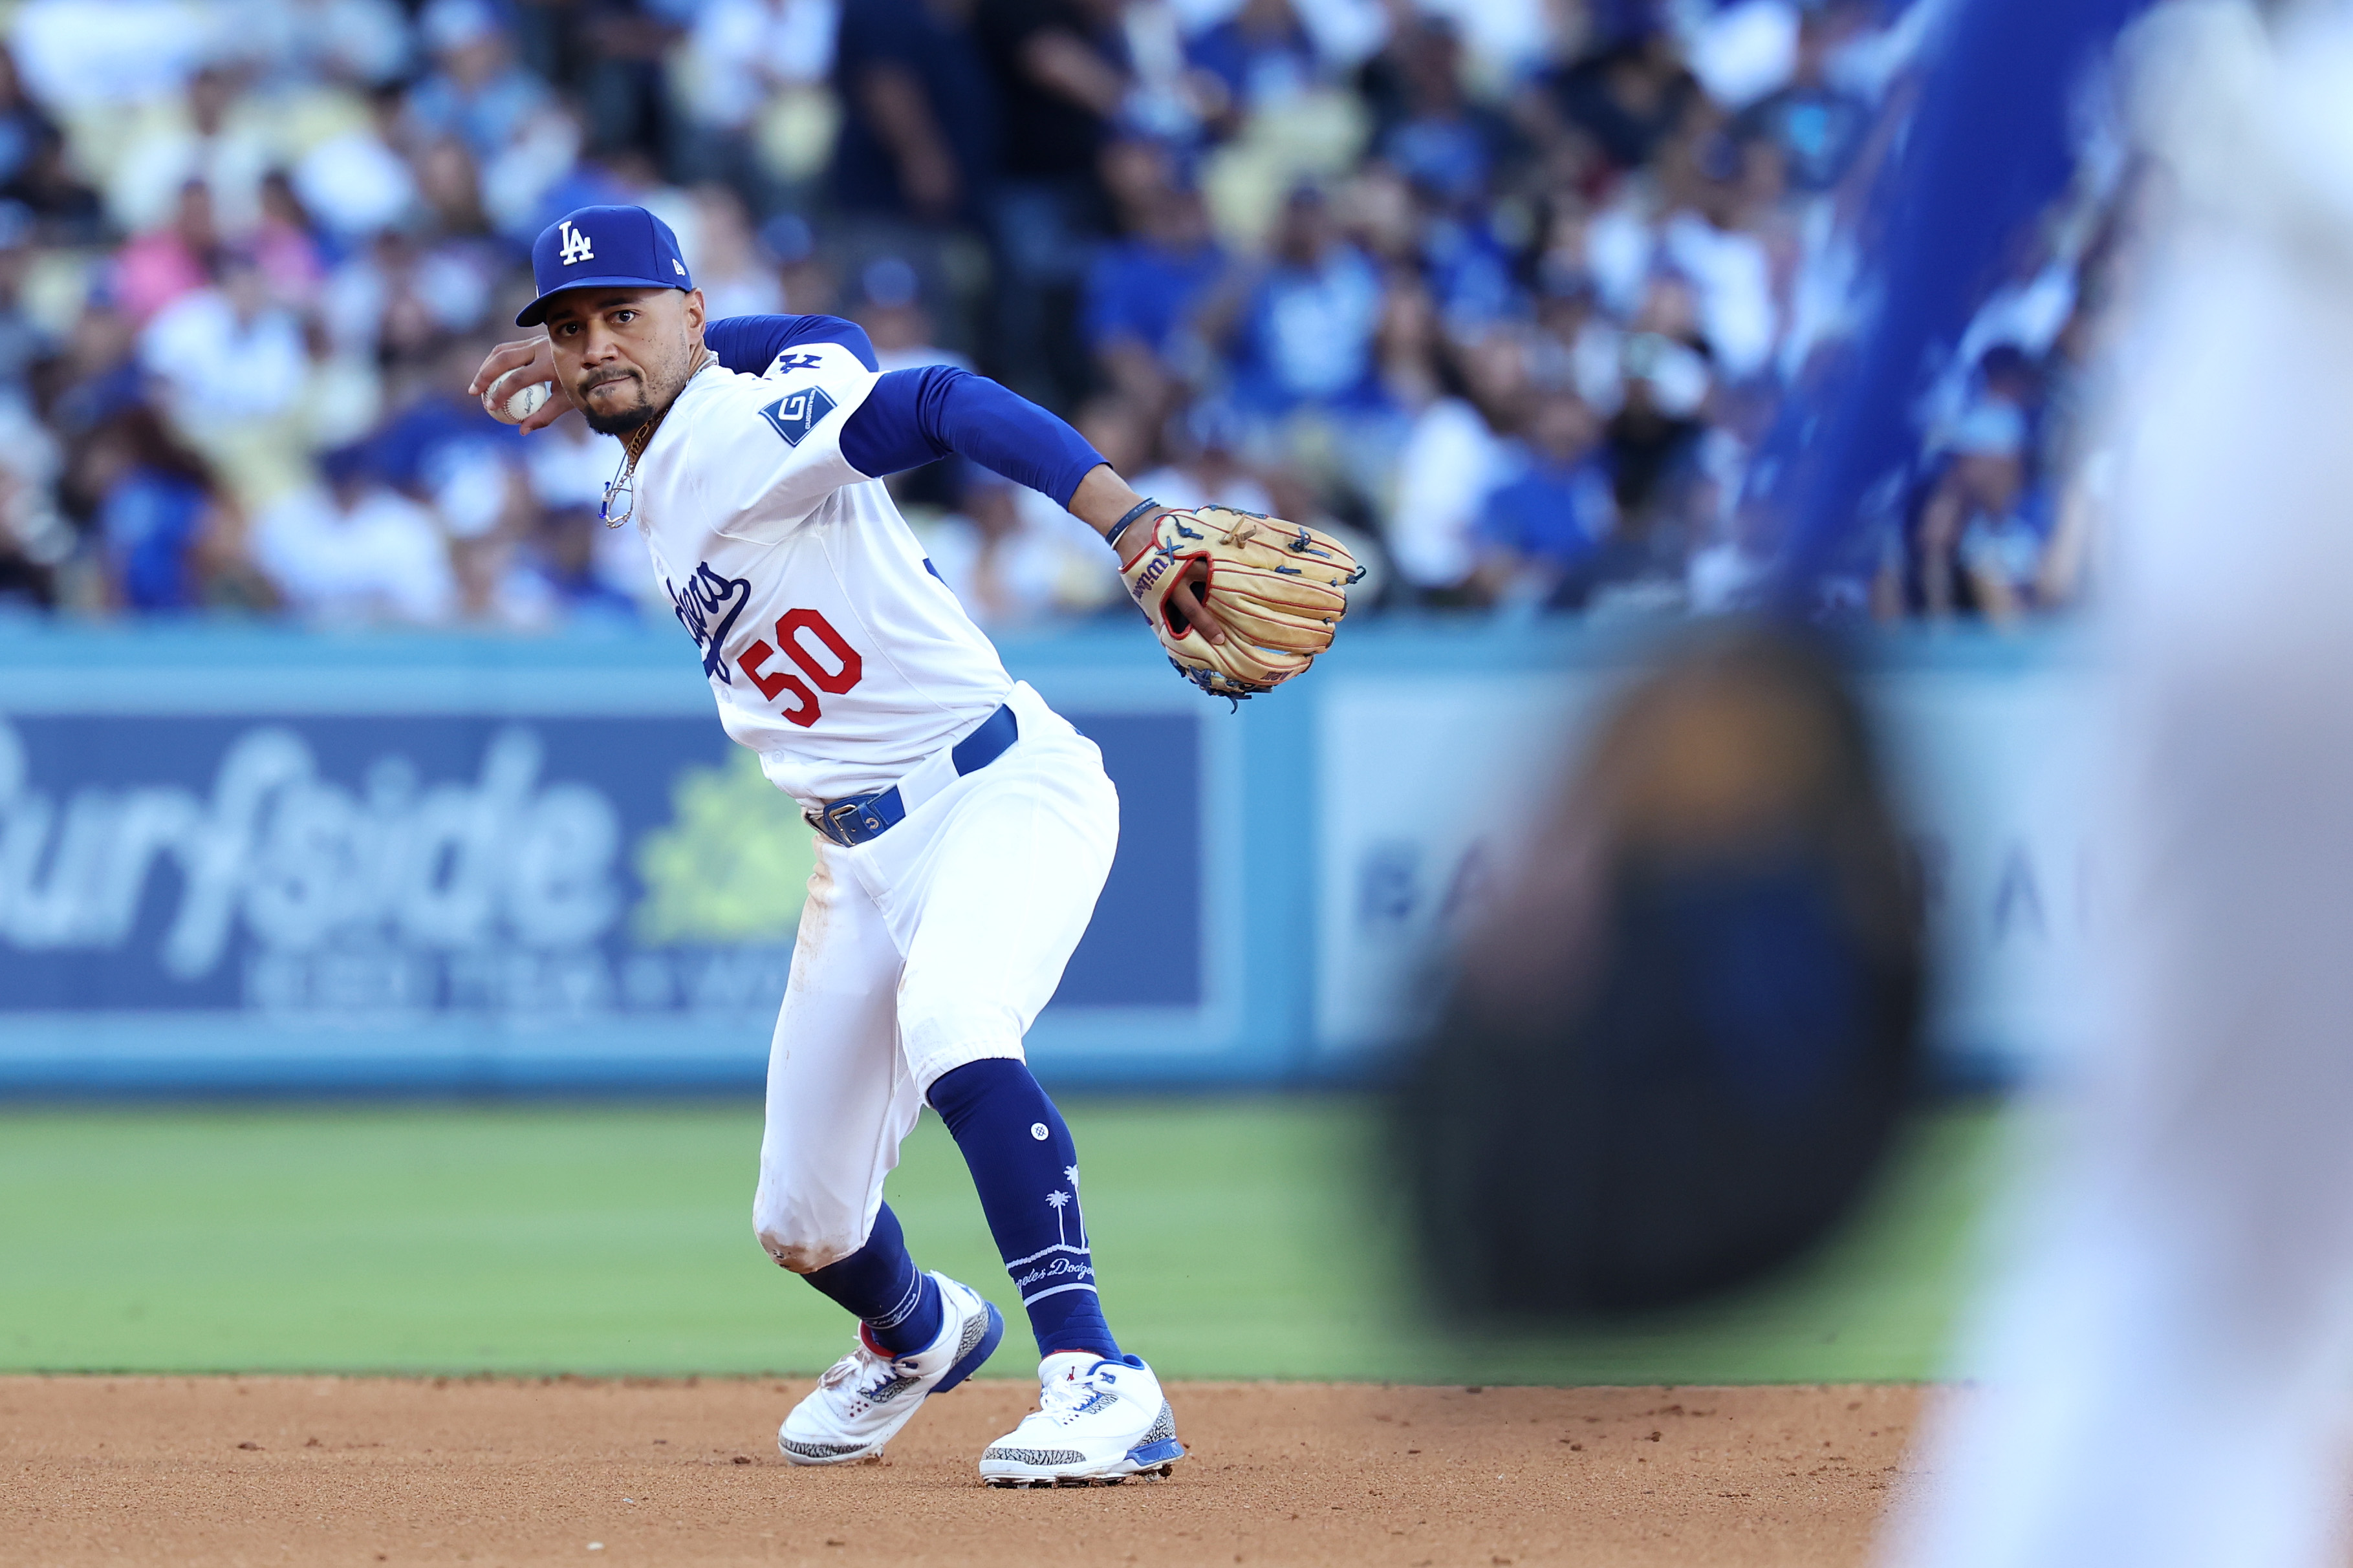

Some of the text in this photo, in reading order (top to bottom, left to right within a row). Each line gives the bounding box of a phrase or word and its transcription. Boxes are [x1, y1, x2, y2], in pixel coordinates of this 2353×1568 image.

[559, 220, 594, 266] LA
[778, 396, 807, 421] G
[1133, 558, 1169, 599] Wilson
[737, 608, 862, 727] 50
[0, 714, 622, 980] urfside
